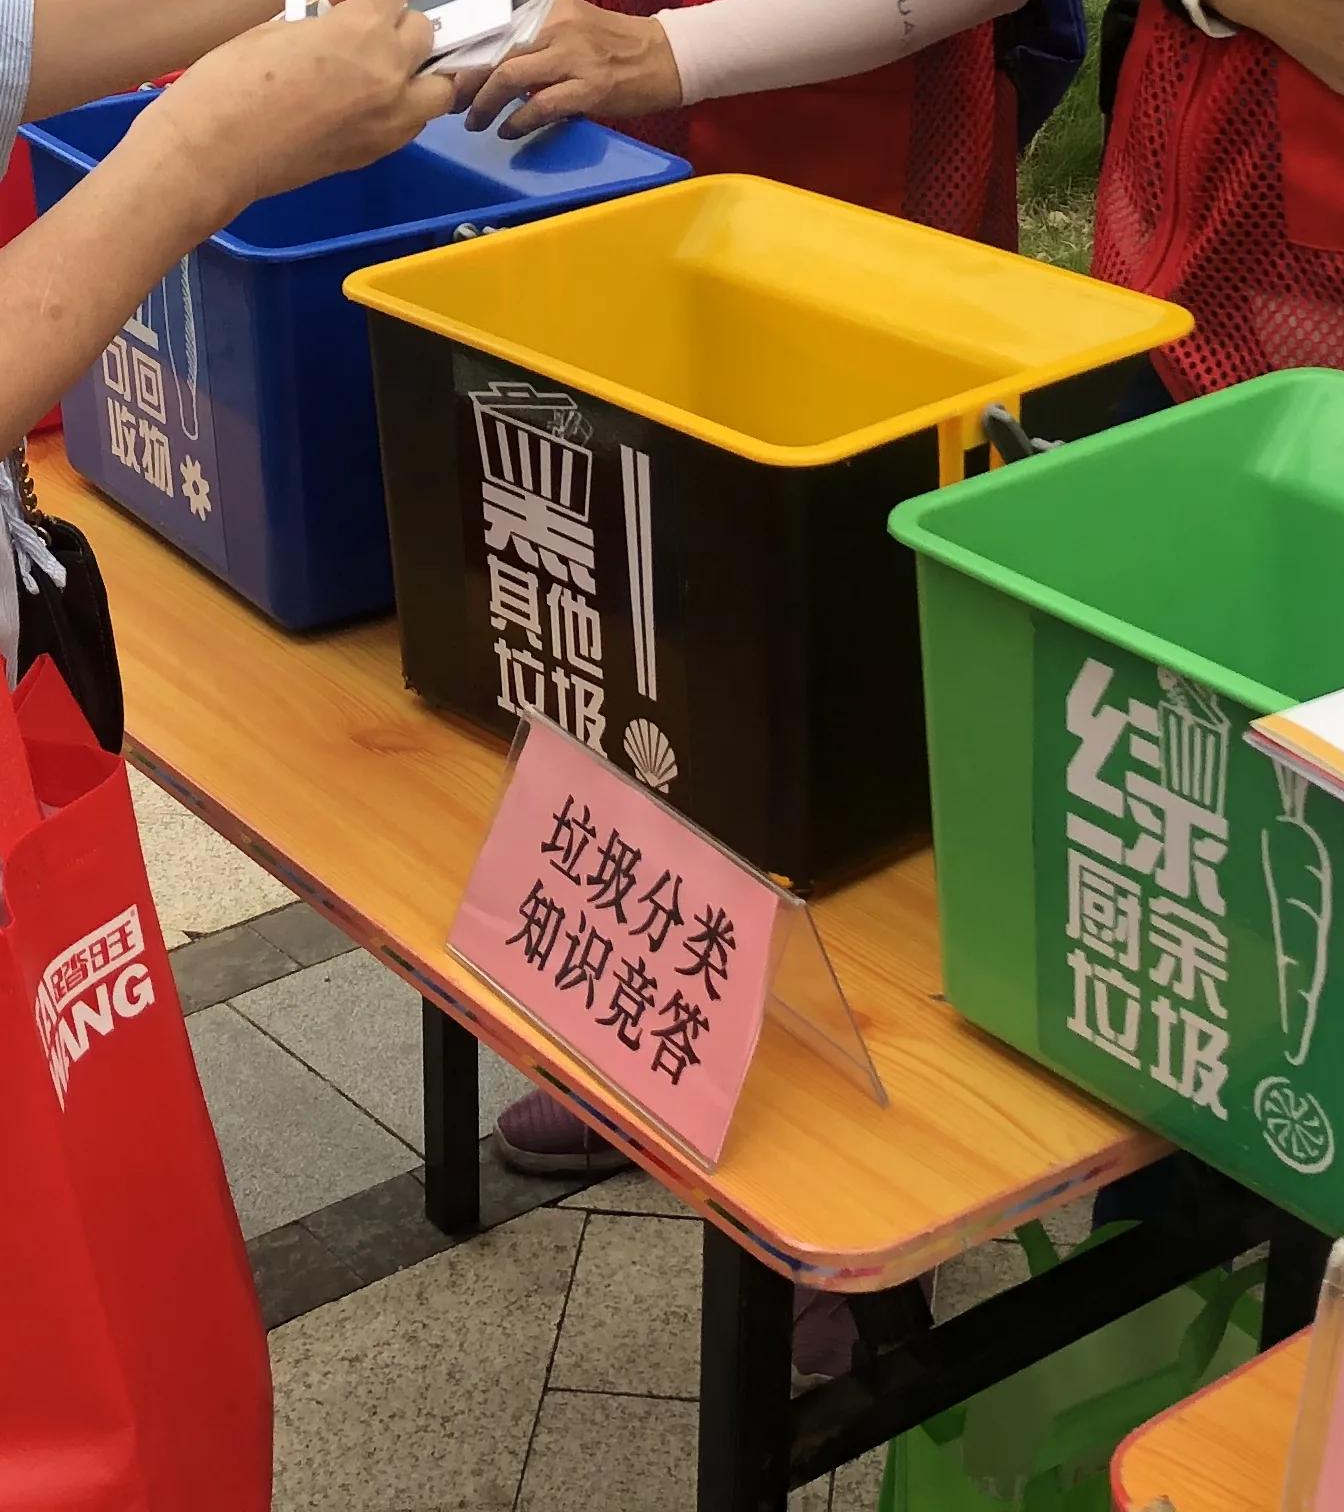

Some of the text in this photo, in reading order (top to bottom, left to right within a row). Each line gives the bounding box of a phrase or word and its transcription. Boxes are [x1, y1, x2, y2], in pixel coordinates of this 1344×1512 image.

[107, 398, 174, 498] 收物
[487, 554, 603, 679] 其他
[493, 638, 608, 758] 垃圾
[540, 794, 737, 1001] 垃圾分类
[1066, 849, 1228, 1020] 厨余
[49, 962, 156, 1114] WANG
[504, 877, 710, 1087] 知识竞答
[1066, 949, 1229, 1121] 垃圾
